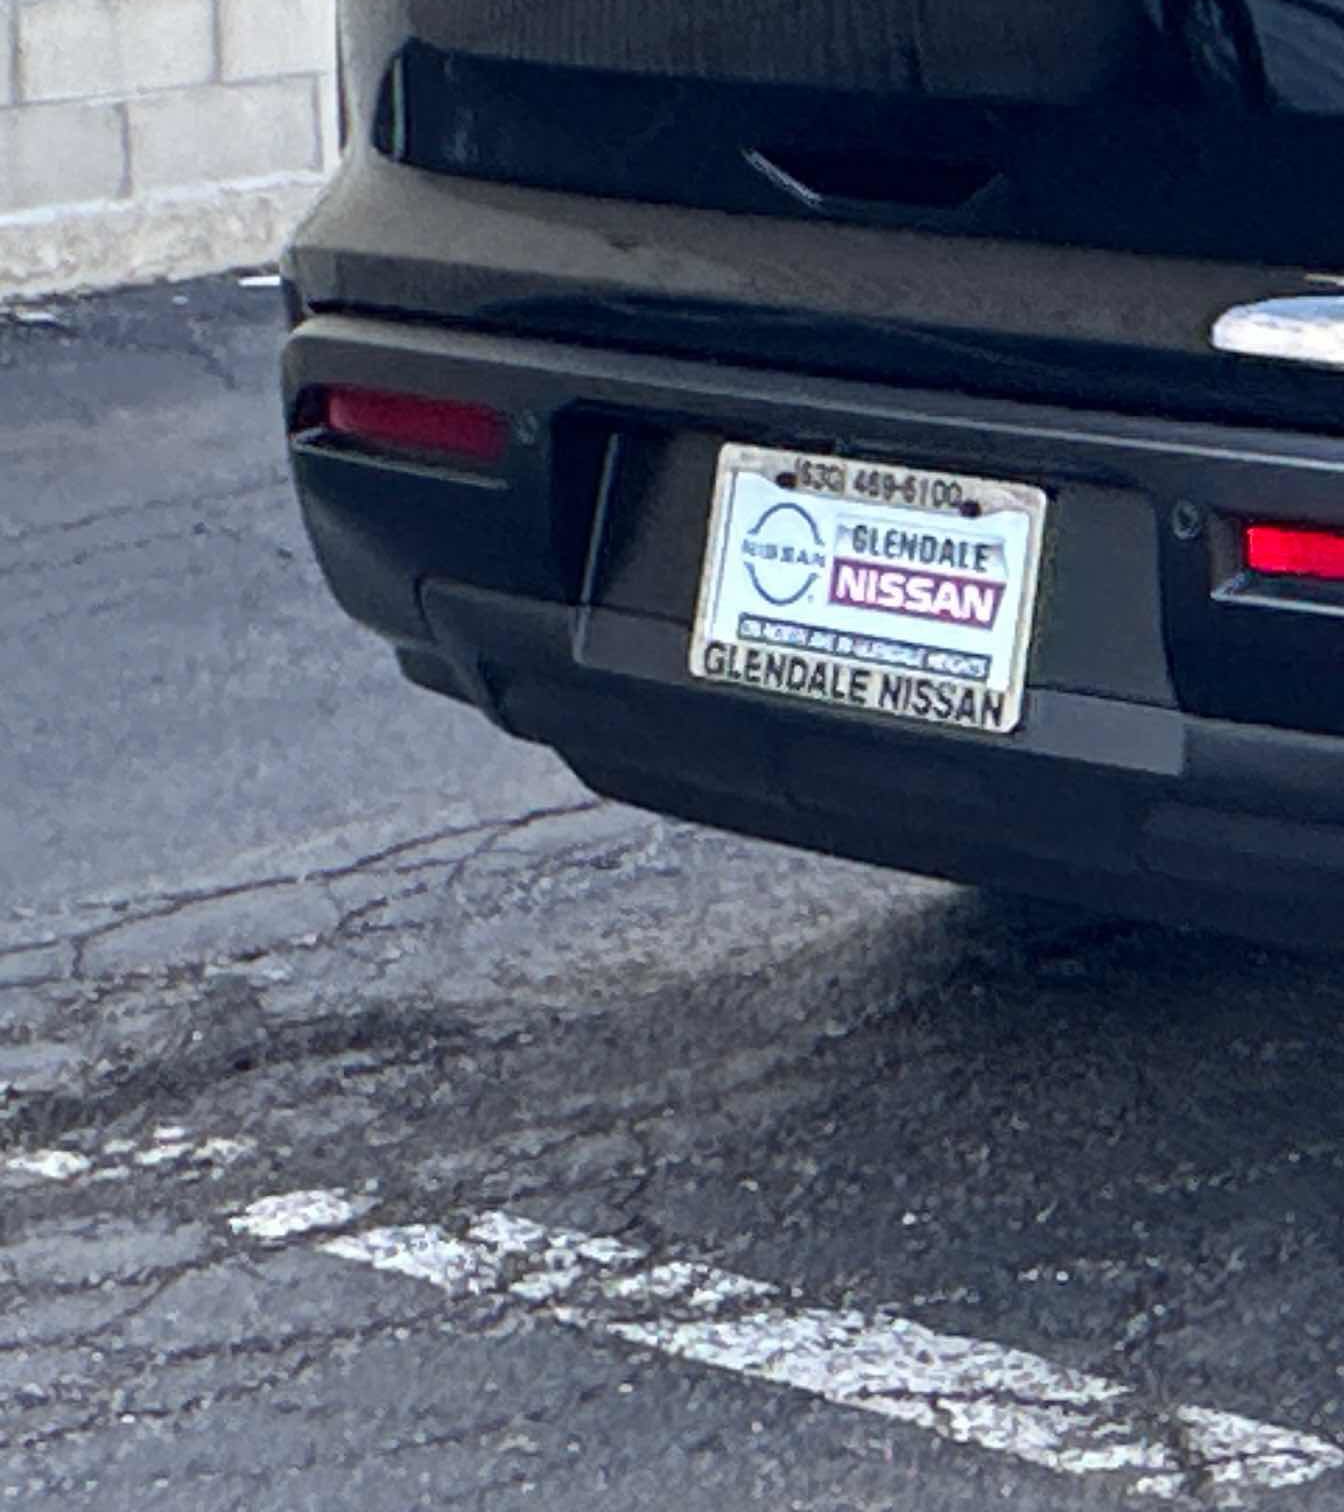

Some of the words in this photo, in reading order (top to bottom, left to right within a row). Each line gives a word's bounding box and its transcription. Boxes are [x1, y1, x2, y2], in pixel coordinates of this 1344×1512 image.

[741, 538, 826, 568] NISSAN
[850, 522, 990, 574] GLENDALE
[835, 566, 996, 623] NISSAN
[703, 641, 870, 704] GLENDALE
[878, 672, 1005, 728] NISSAN
